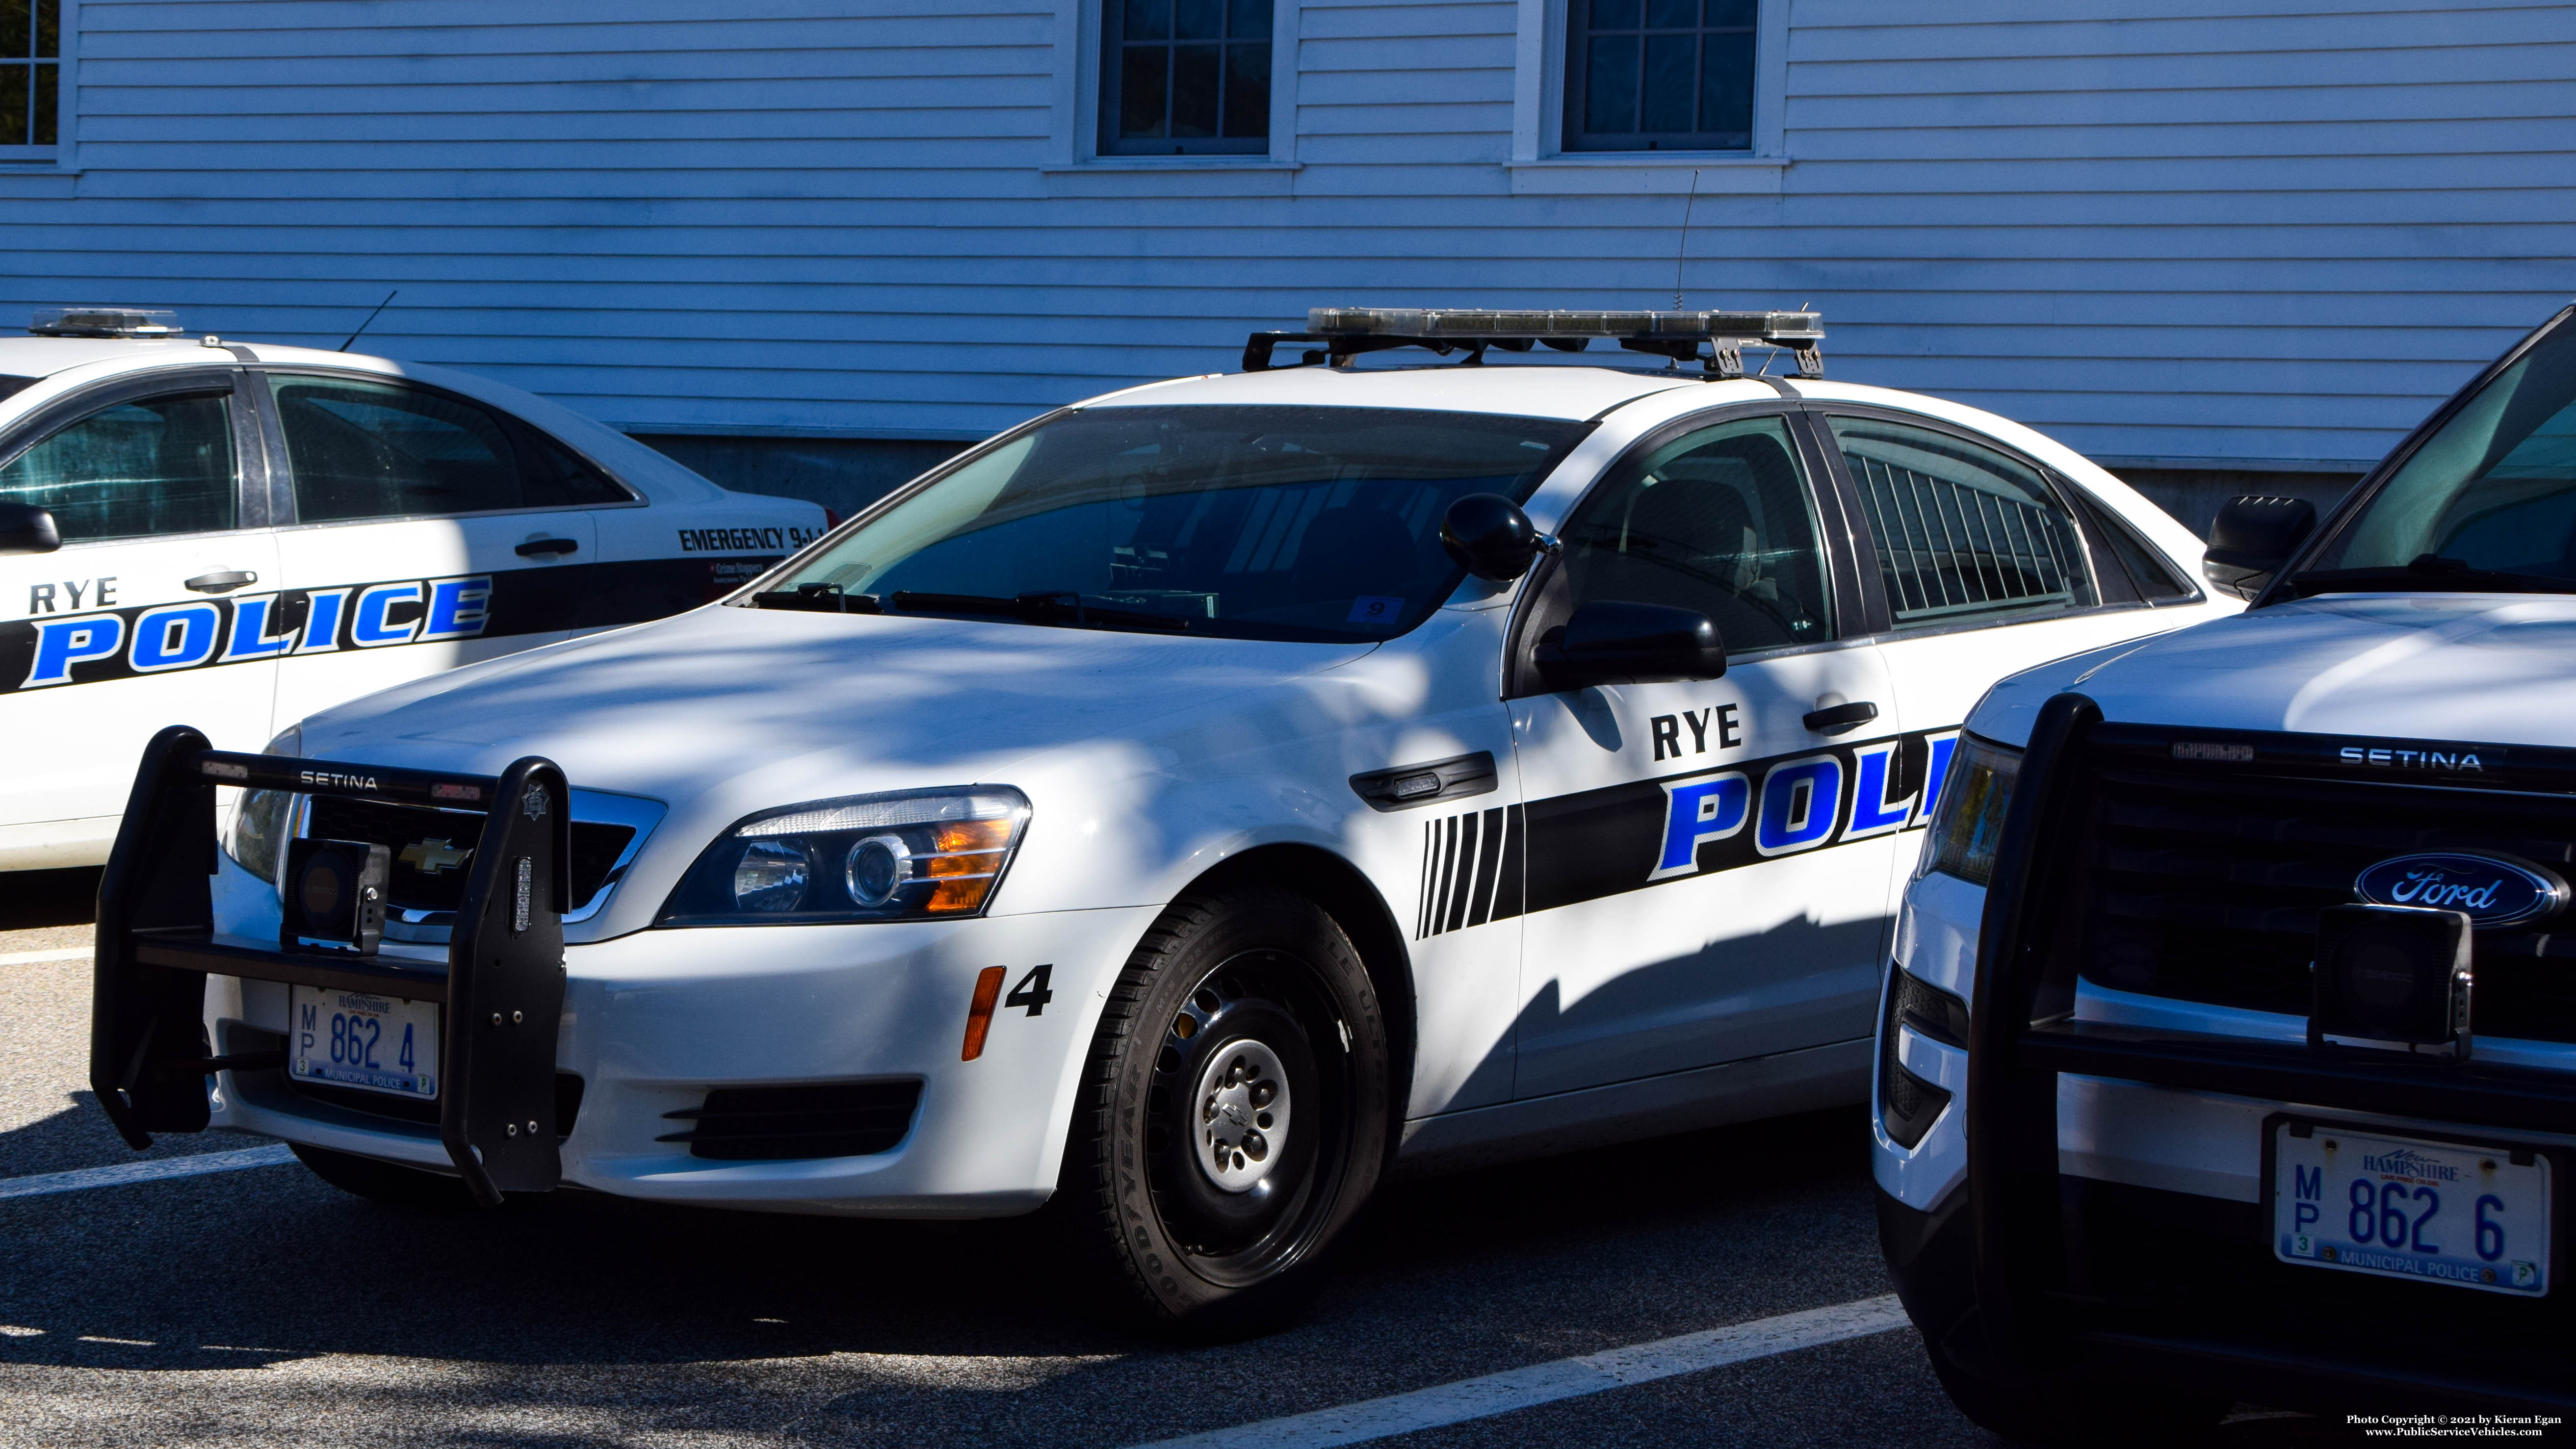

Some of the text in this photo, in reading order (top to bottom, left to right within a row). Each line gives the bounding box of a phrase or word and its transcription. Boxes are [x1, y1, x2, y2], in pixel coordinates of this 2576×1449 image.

[678, 527, 784, 551] EMERGENCY
[30, 576, 117, 615] RYE
[19, 575, 494, 690] POLICE
[1650, 703, 1742, 761] RYE
[2340, 747, 2484, 772] SETINA
[301, 771, 378, 791] SETINA
[2392, 863, 2503, 909] Ford
[1005, 964, 1053, 1017] 4
[338, 995, 391, 1013] HAMPSHIRE
[331, 1013, 414, 1073] 862 4
[300, 1060, 306, 1071] 3
[325, 1068, 401, 1089] MUNICIPAL POLICE
[2364, 1155, 2459, 1182] HAMPSHIRE
[2380, 1149, 2440, 1163] New
[2349, 1178, 2504, 1261] 862 6
[2298, 1237, 2308, 1251] 3
[2341, 1250, 2480, 1283] MUNICIPAL POLICE
[2519, 1266, 2527, 1280] P
